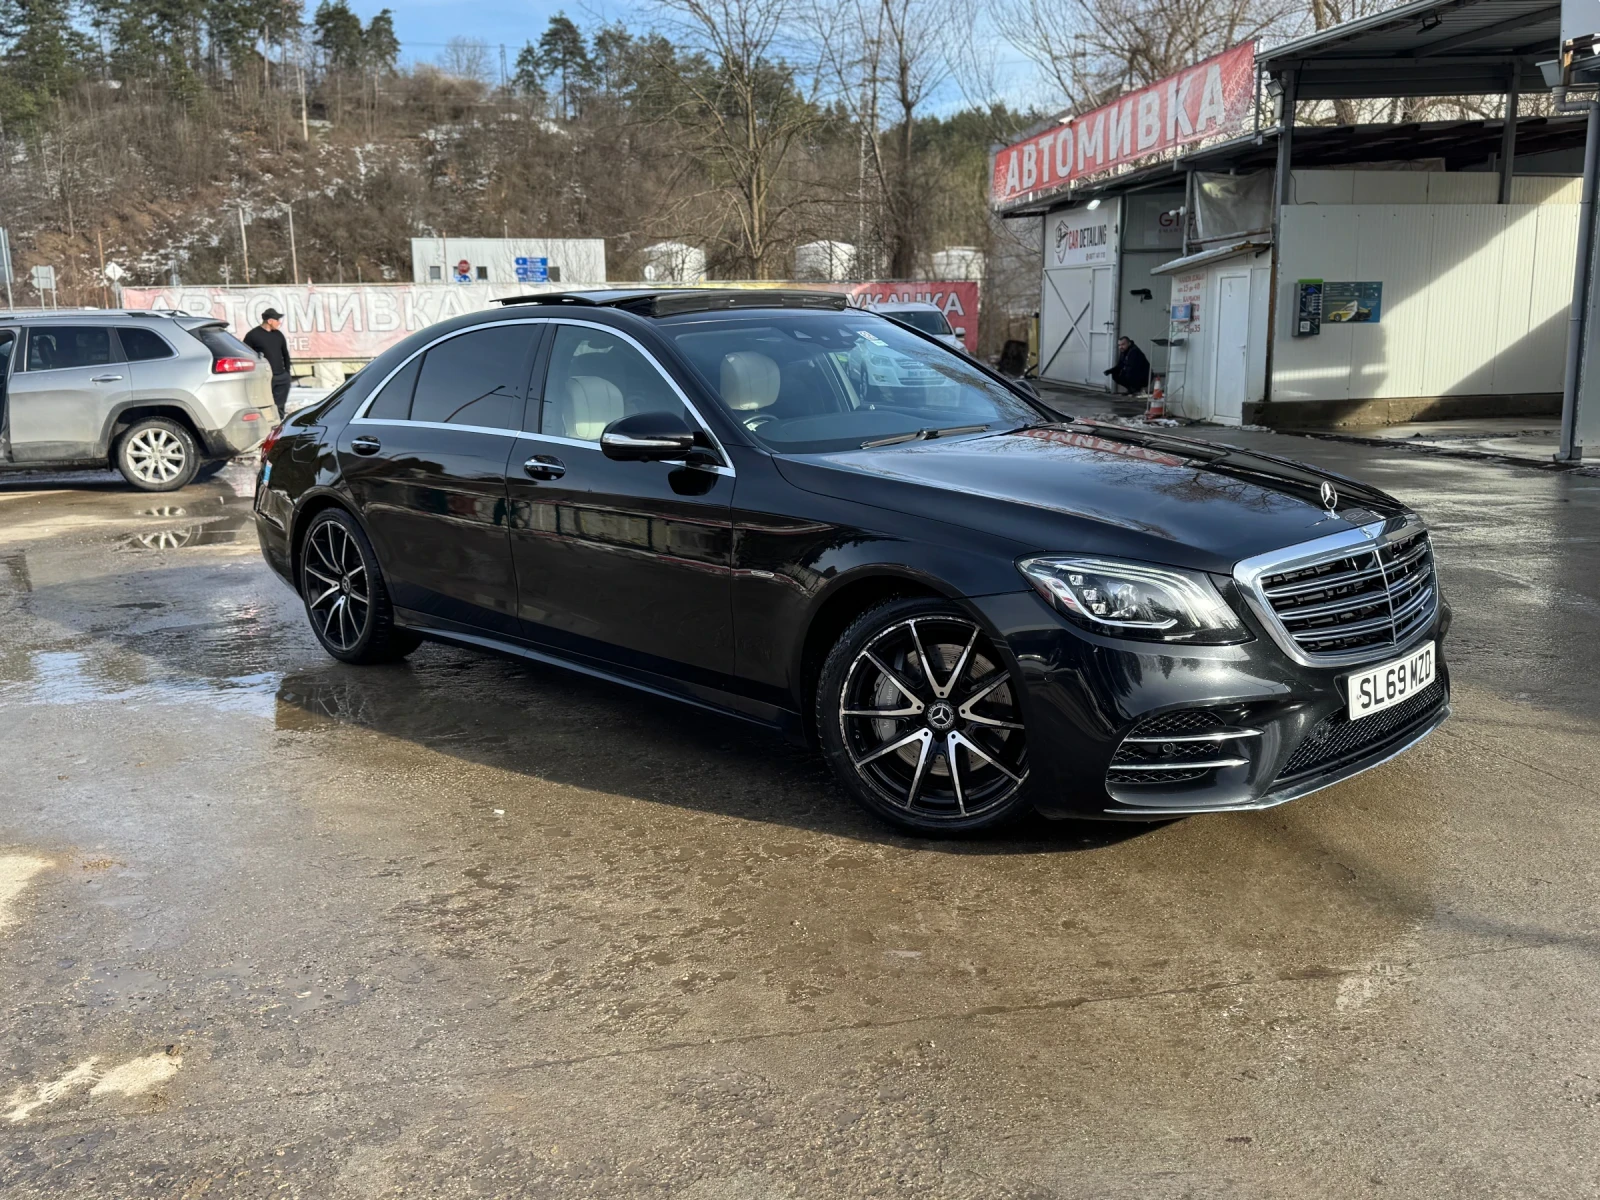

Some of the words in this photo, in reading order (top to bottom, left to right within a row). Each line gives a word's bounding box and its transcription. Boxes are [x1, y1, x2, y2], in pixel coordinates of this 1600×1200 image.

[1004, 63, 1226, 195] АВТОМИВКА
[1068, 230, 1079, 250] CAR
[1080, 224, 1107, 248] DETAILING
[1359, 664, 1407, 709] SL69
[1410, 649, 1431, 690] MZD
